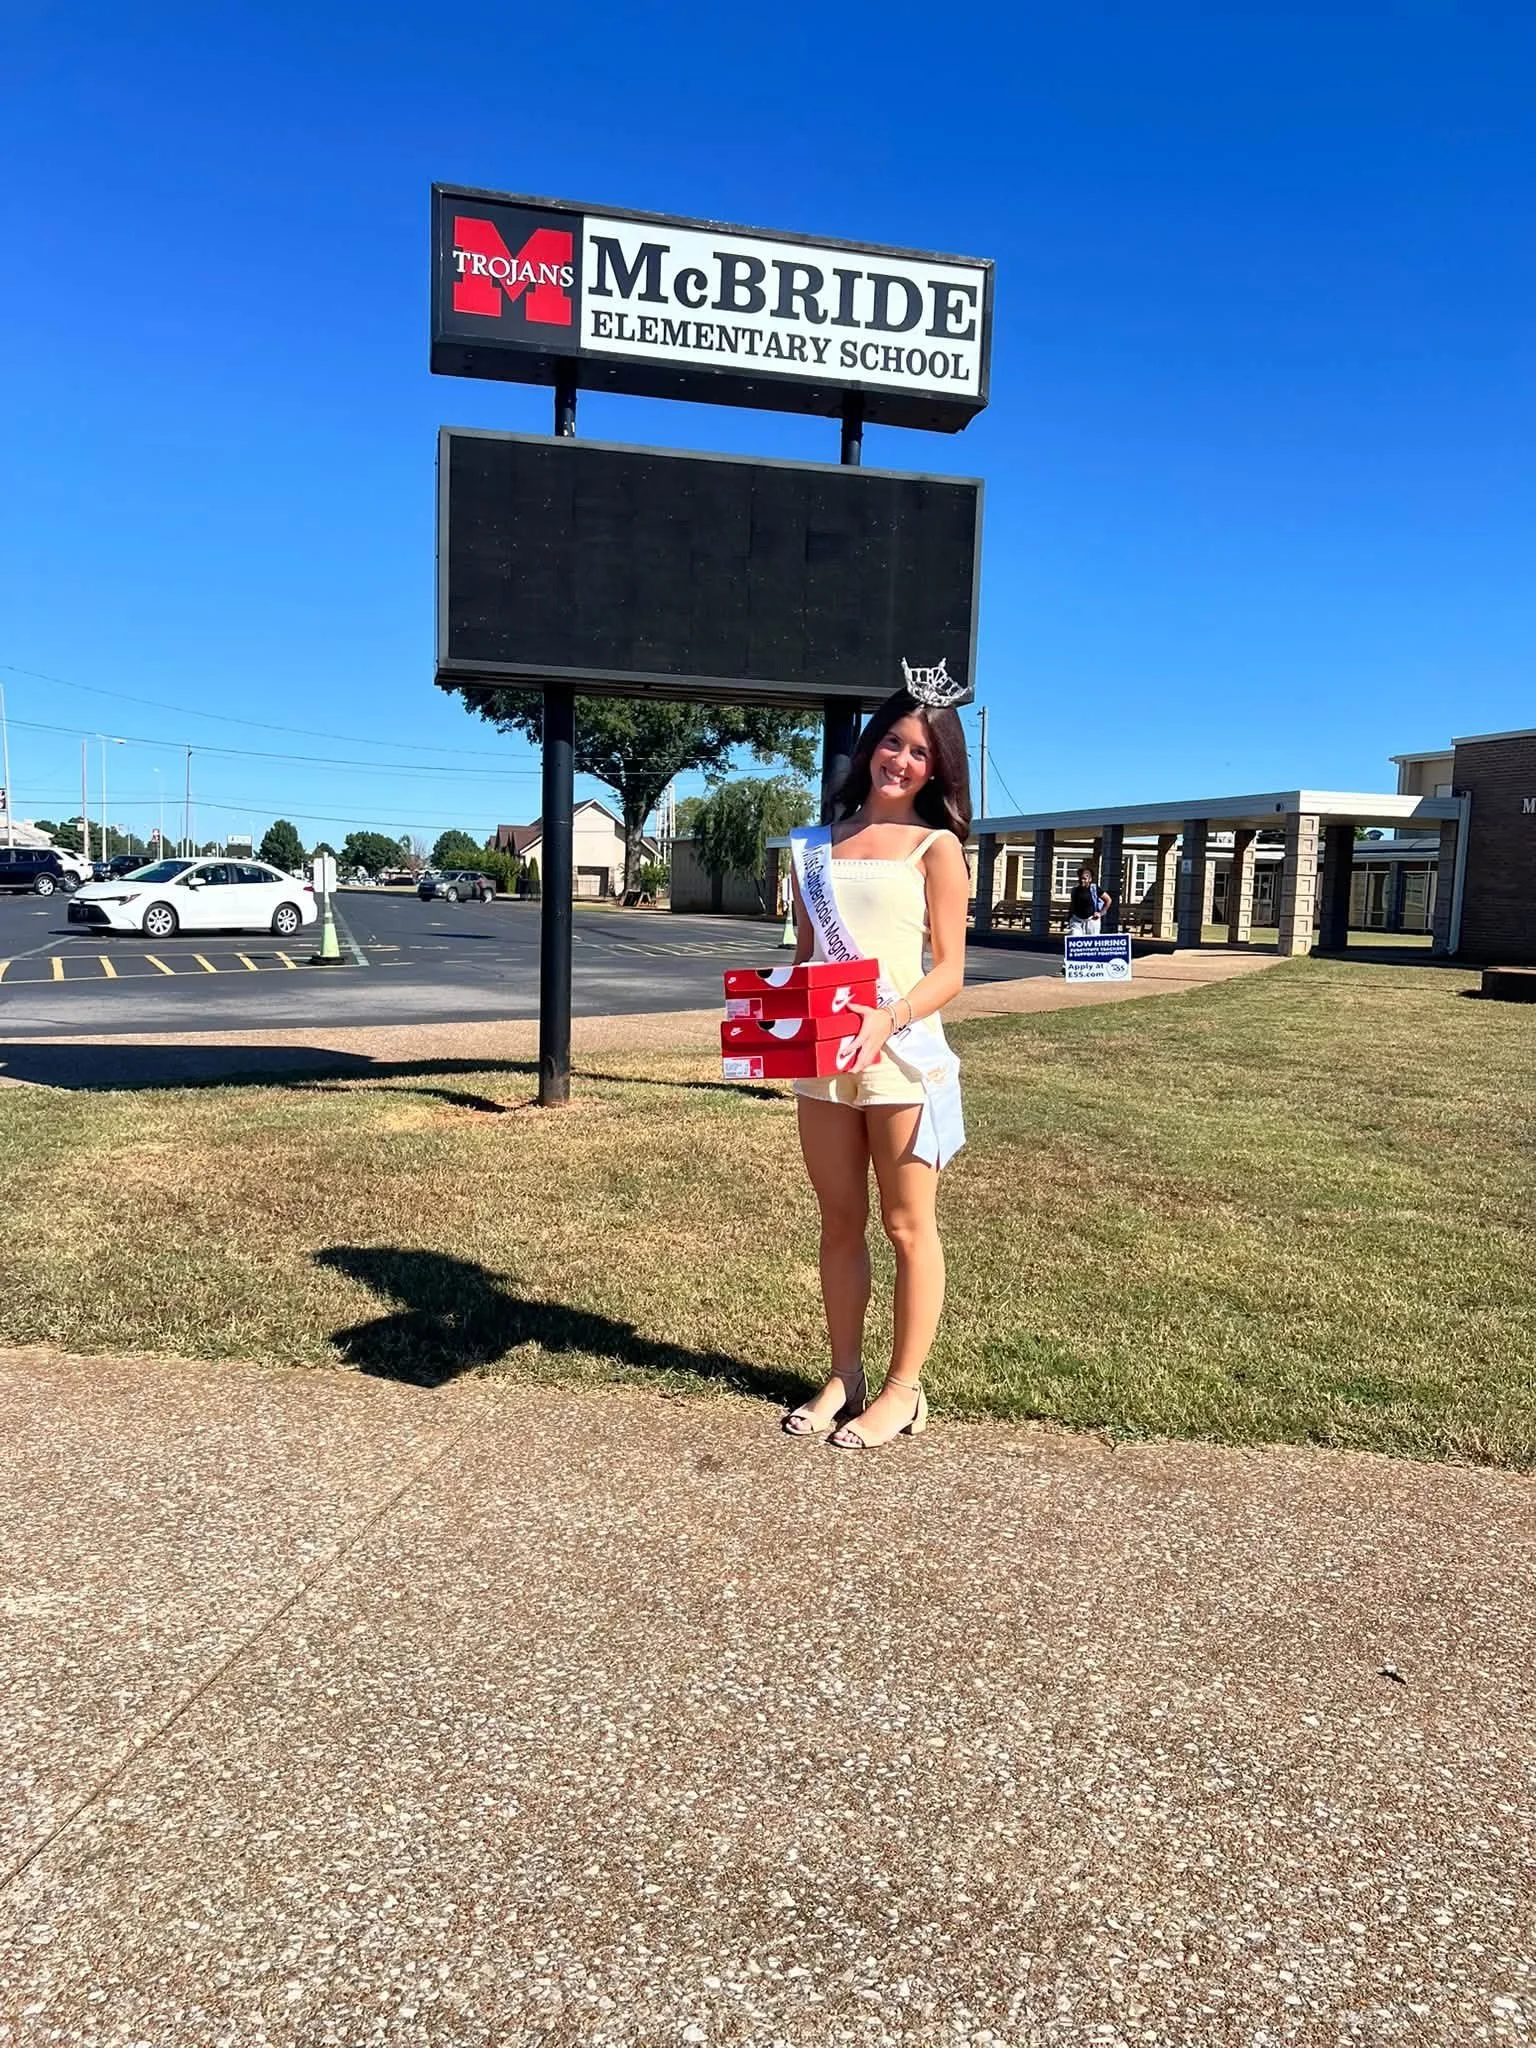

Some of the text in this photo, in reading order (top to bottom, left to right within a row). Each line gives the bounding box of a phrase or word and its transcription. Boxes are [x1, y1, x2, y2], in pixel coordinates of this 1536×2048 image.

[452, 249, 575, 288] TROJANS
[453, 215, 573, 326] M
[588, 234, 978, 342] McBRIDE
[590, 309, 970, 381] ELEMENTARY SCHOOL
[824, 920, 859, 962] Magno
[1068, 939, 1127, 948] NOW HIRING
